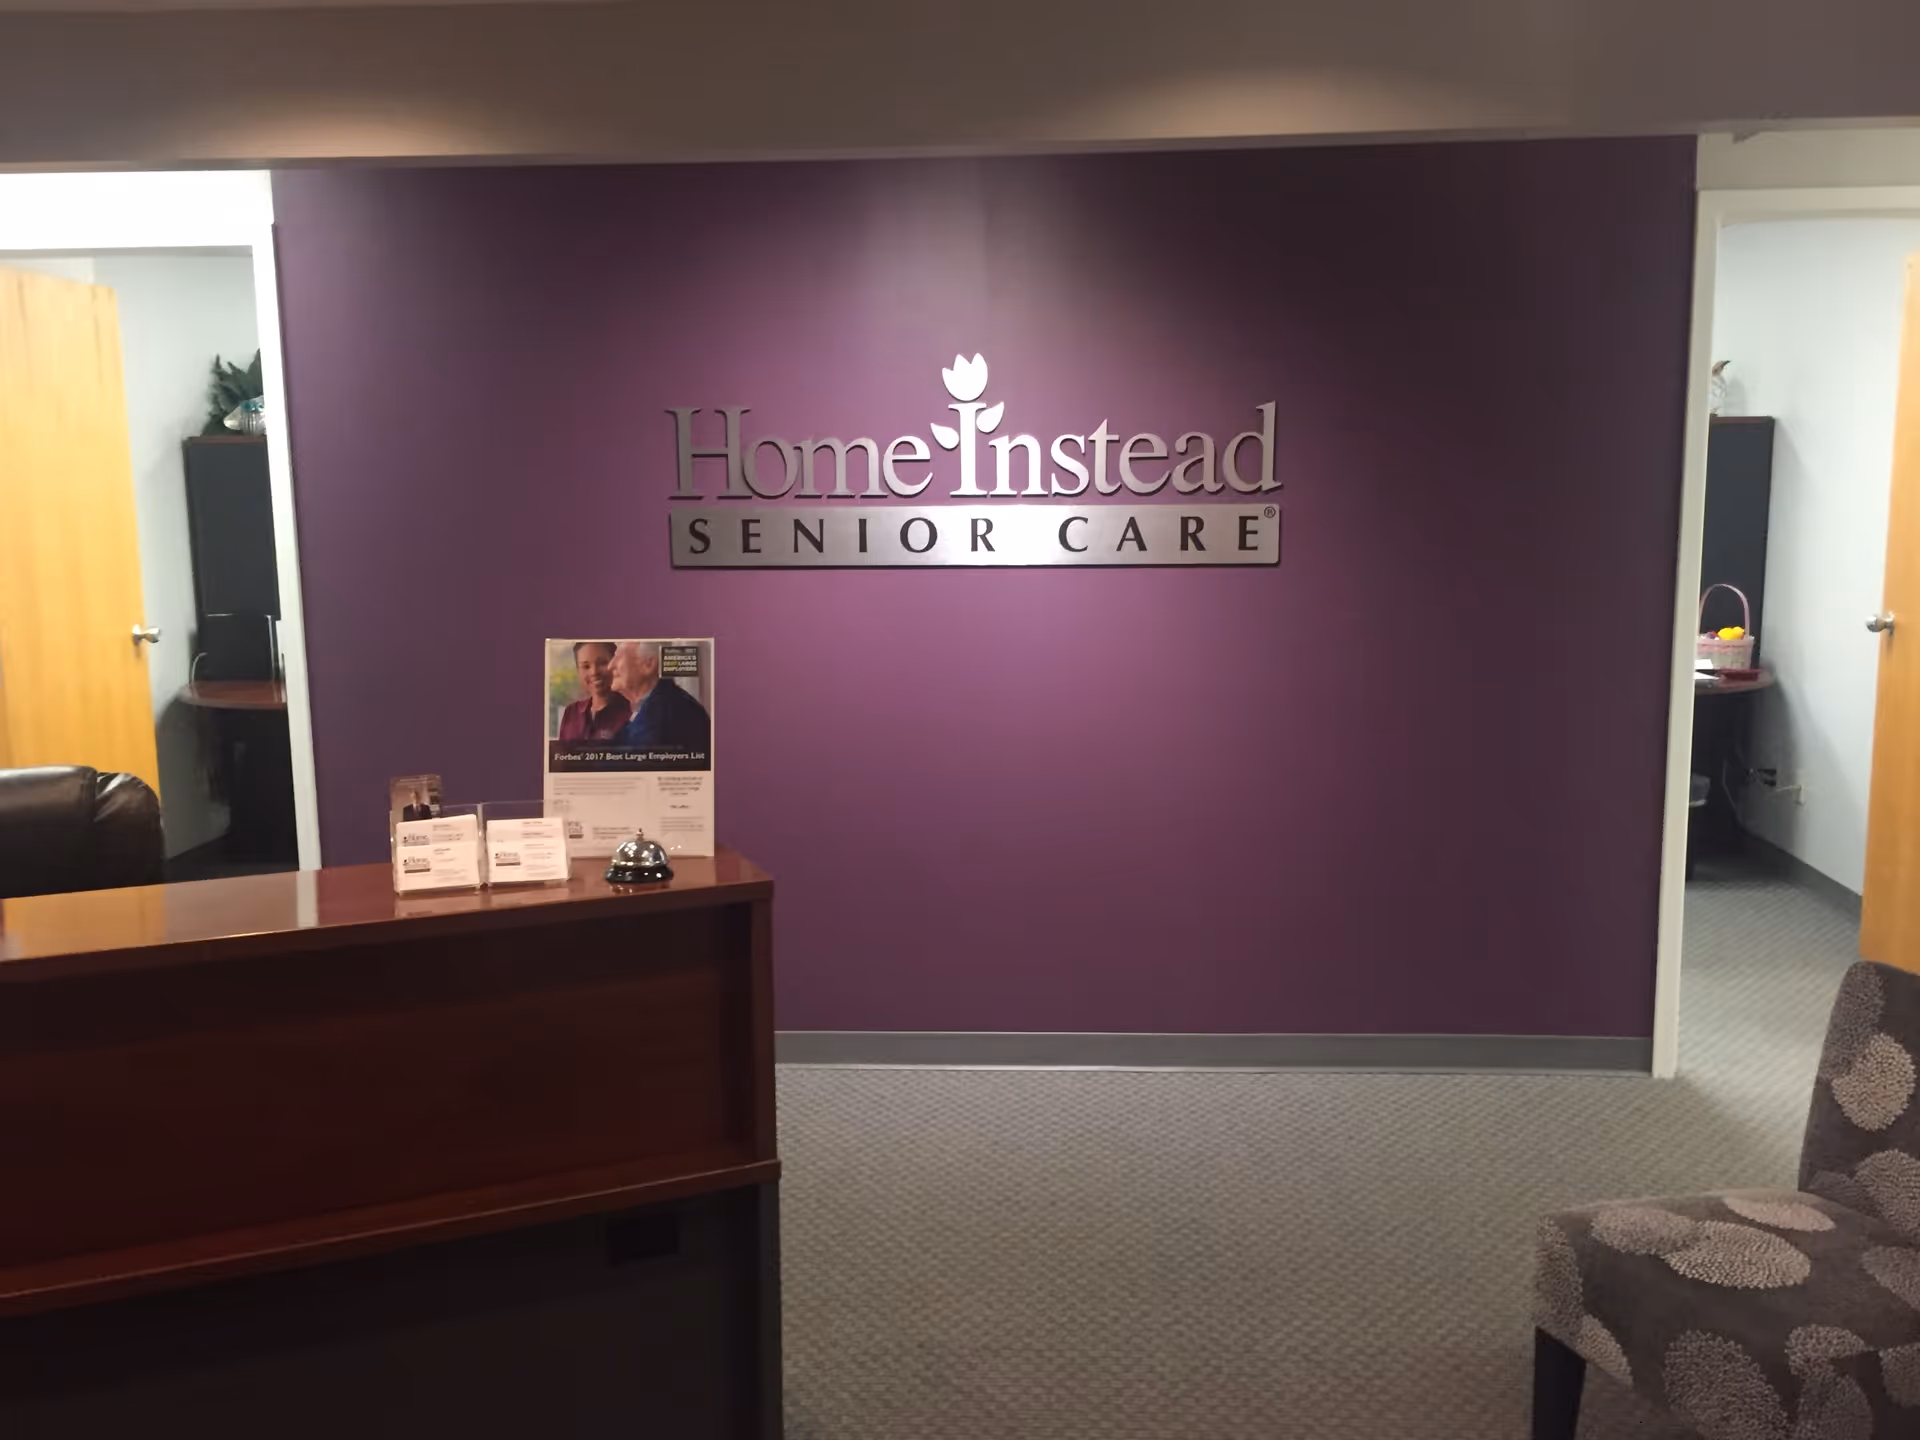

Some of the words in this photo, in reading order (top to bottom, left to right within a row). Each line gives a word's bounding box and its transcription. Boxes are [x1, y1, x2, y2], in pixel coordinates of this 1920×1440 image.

[664, 406, 934, 500] Home
[947, 401, 1283, 498] Instead
[688, 516, 996, 555] SENIOR
[585, 752, 604, 761] 2017
[606, 752, 624, 760] Best
[625, 752, 647, 762] Large
[648, 751, 689, 762] Employers
[690, 751, 705, 760] List
